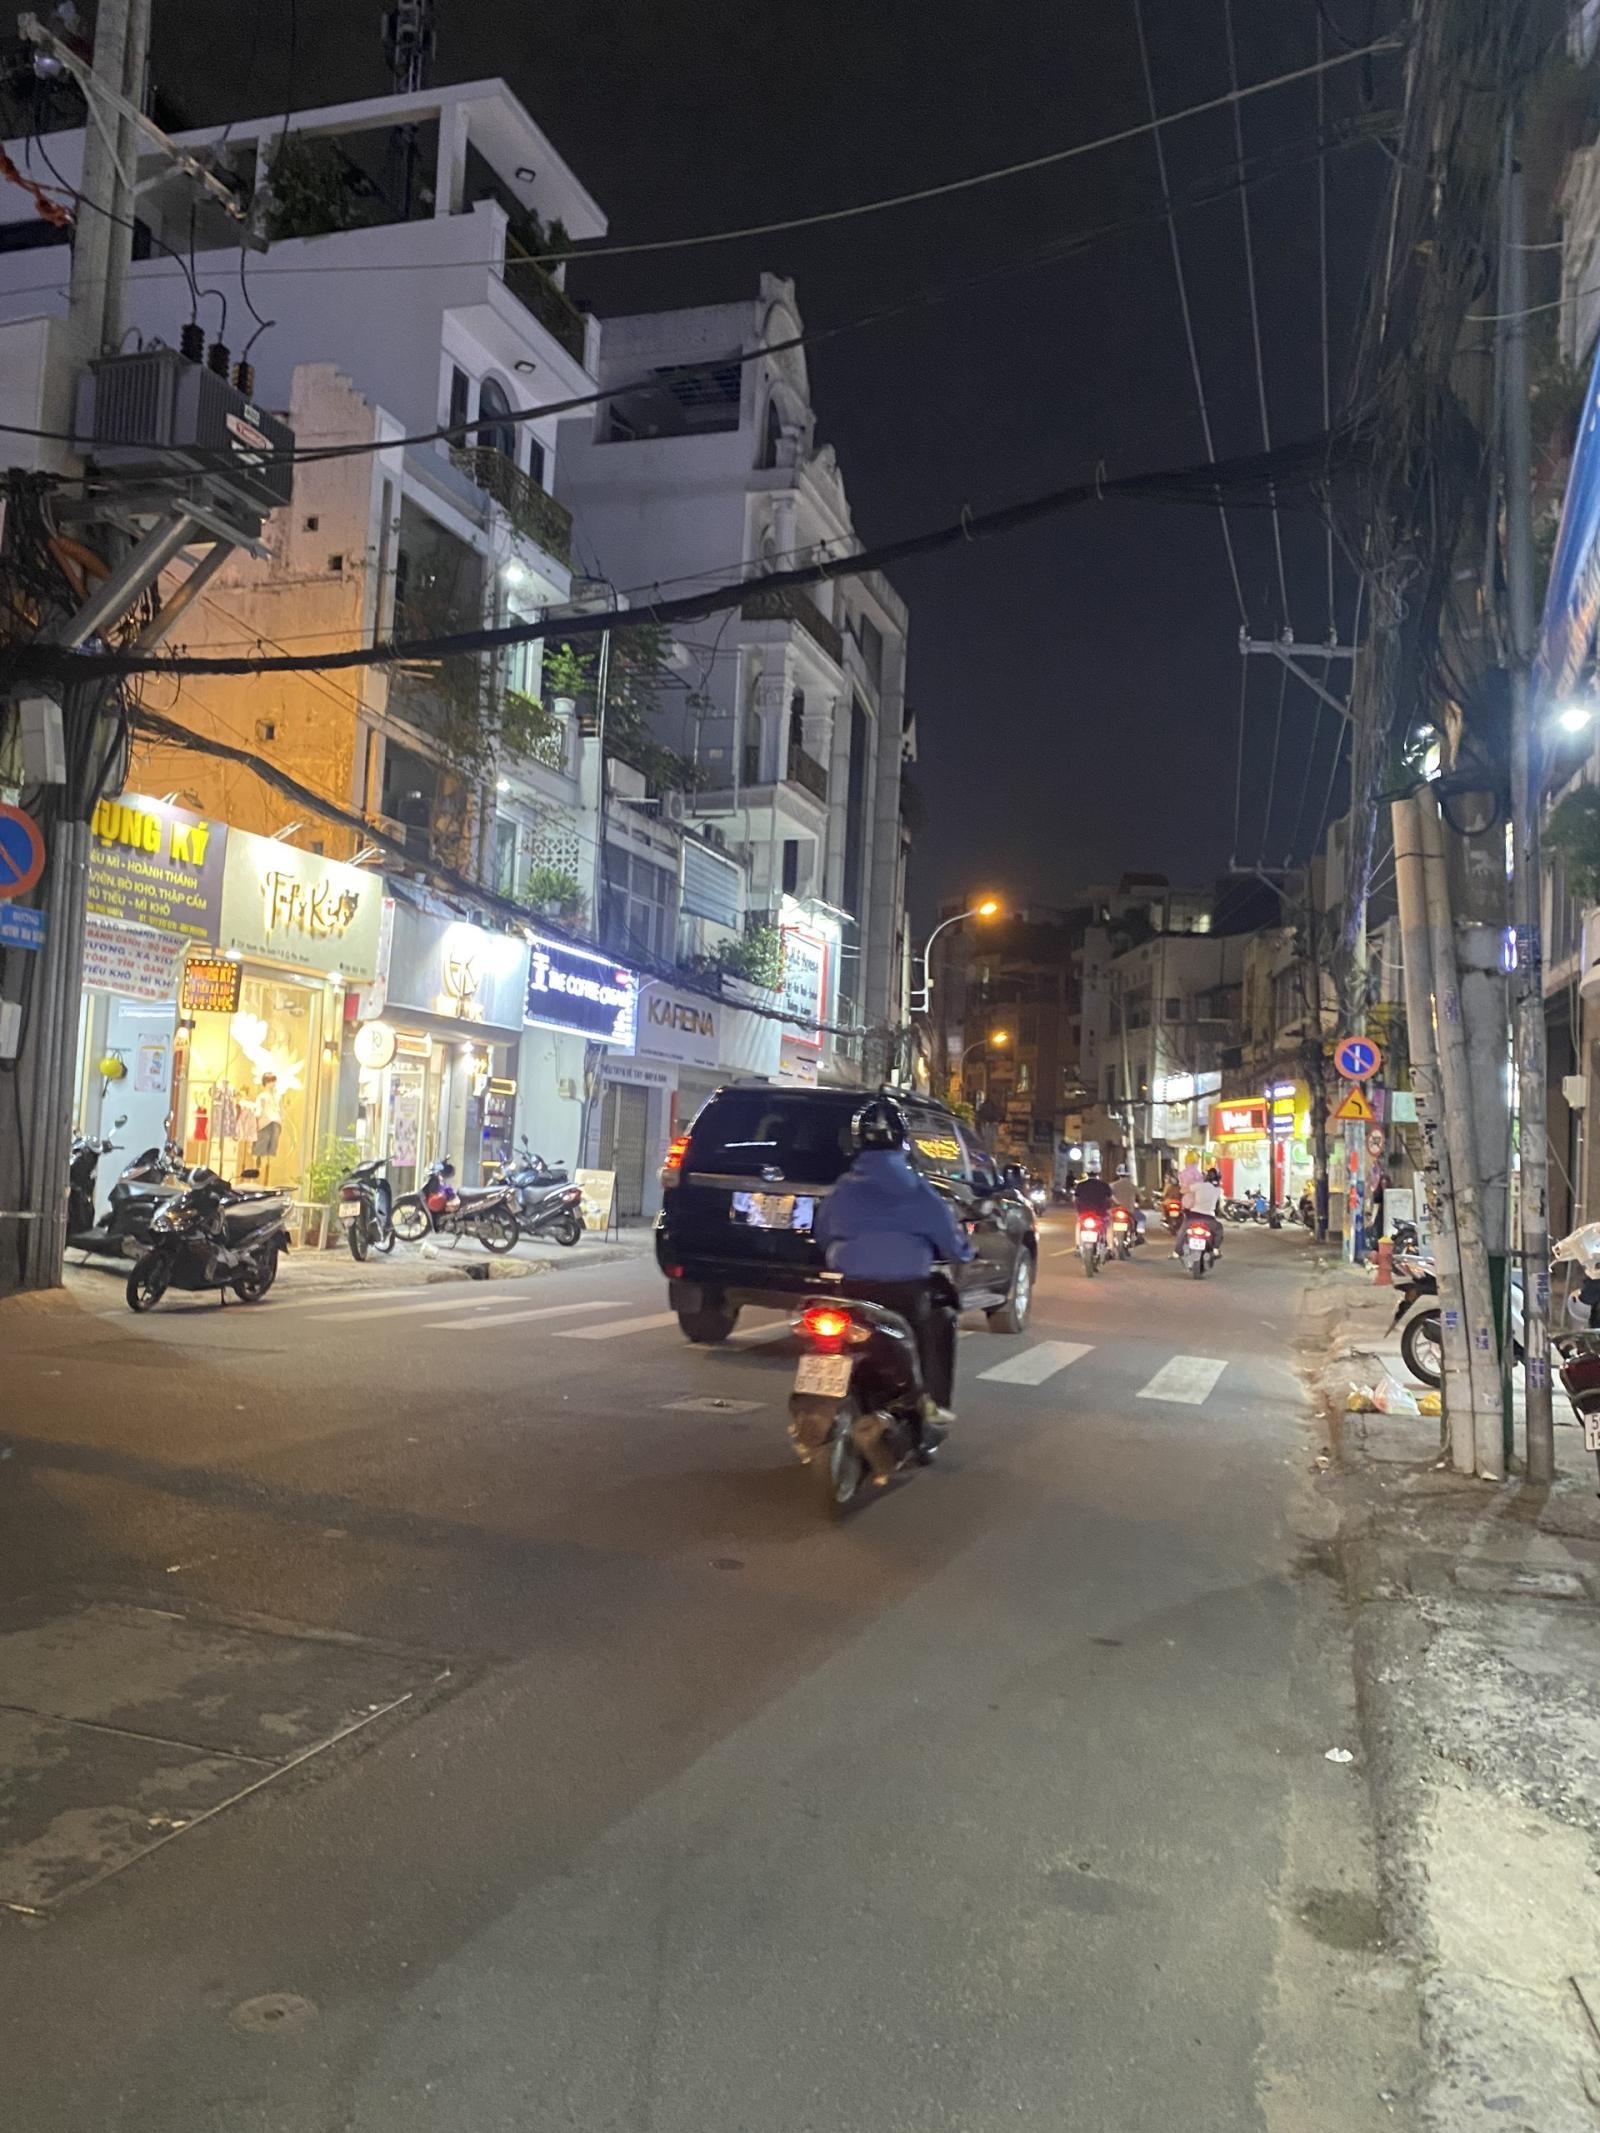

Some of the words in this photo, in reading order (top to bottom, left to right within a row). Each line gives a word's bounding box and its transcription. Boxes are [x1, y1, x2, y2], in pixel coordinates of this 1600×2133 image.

[127, 859, 163, 881] HOÀNH
[164, 870, 198, 890] THÁNH
[647, 995, 715, 1038] KARENA
